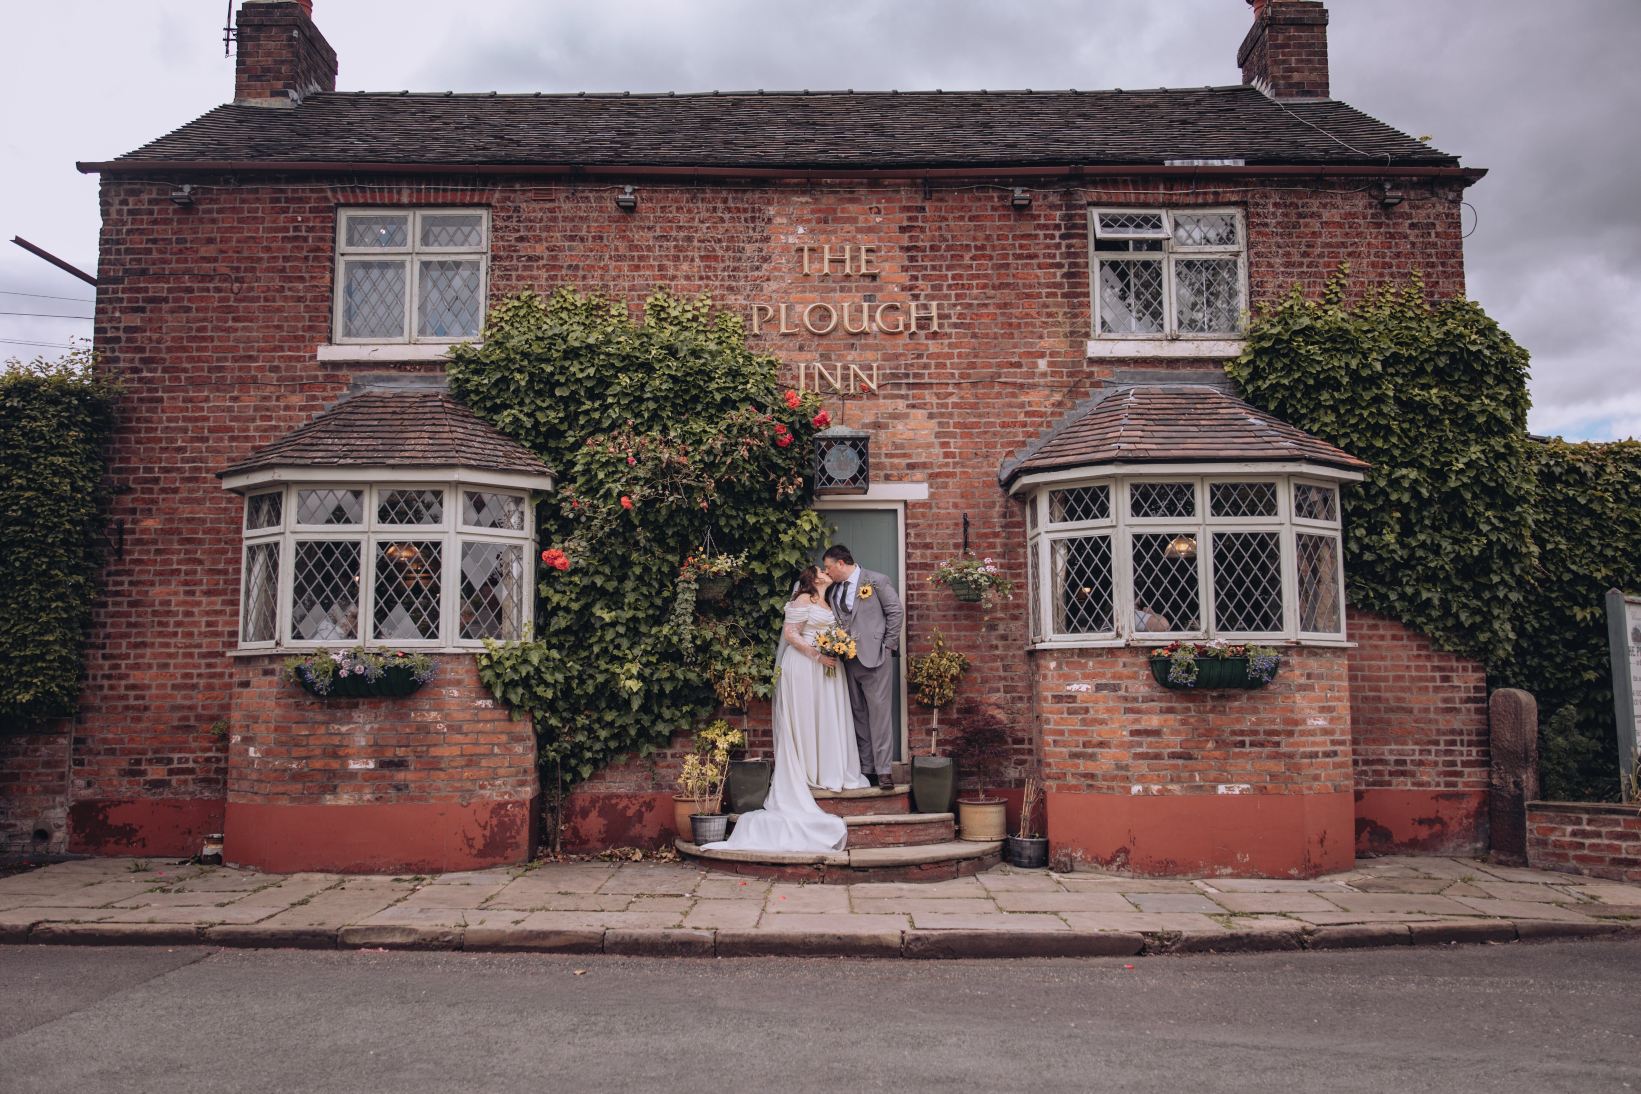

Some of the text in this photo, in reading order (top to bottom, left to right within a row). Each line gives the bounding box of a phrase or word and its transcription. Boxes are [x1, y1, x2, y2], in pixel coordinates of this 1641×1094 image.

[796, 245, 880, 276] THE
[752, 302, 940, 336] PLOUGH
[799, 363, 879, 395] INN
